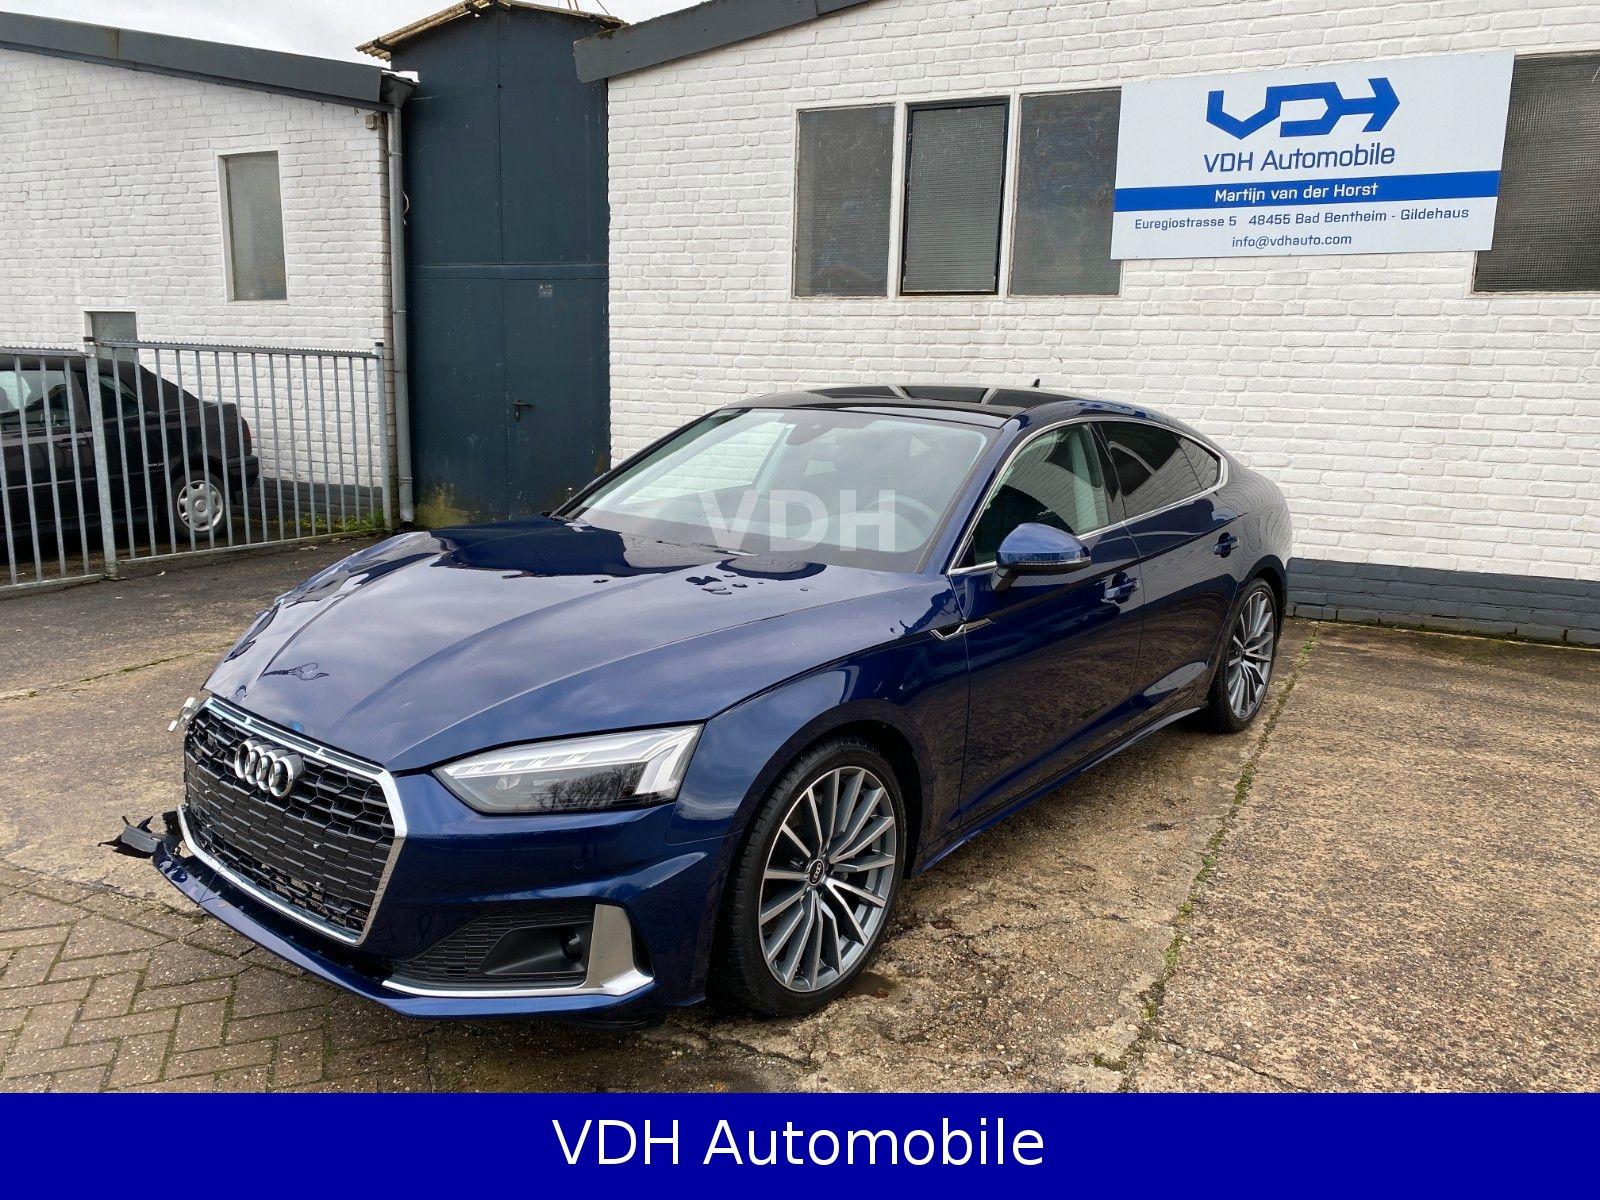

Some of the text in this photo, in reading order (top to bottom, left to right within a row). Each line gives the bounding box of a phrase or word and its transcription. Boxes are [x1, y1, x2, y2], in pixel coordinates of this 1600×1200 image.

[1206, 77, 1400, 140] VDH
[1203, 142, 1395, 173] VDH Automobile
[1214, 182, 1379, 203] Martijn van der Horst
[1134, 216, 1225, 231] Euregiostrasse
[1228, 216, 1237, 226] 5
[1248, 213, 1291, 226] 48455
[1295, 212, 1320, 225] Bad
[1324, 209, 1387, 223] Bentheim
[1400, 207, 1469, 221] Gildehaus
[1232, 234, 1352, 249] info@vdhauto.com
